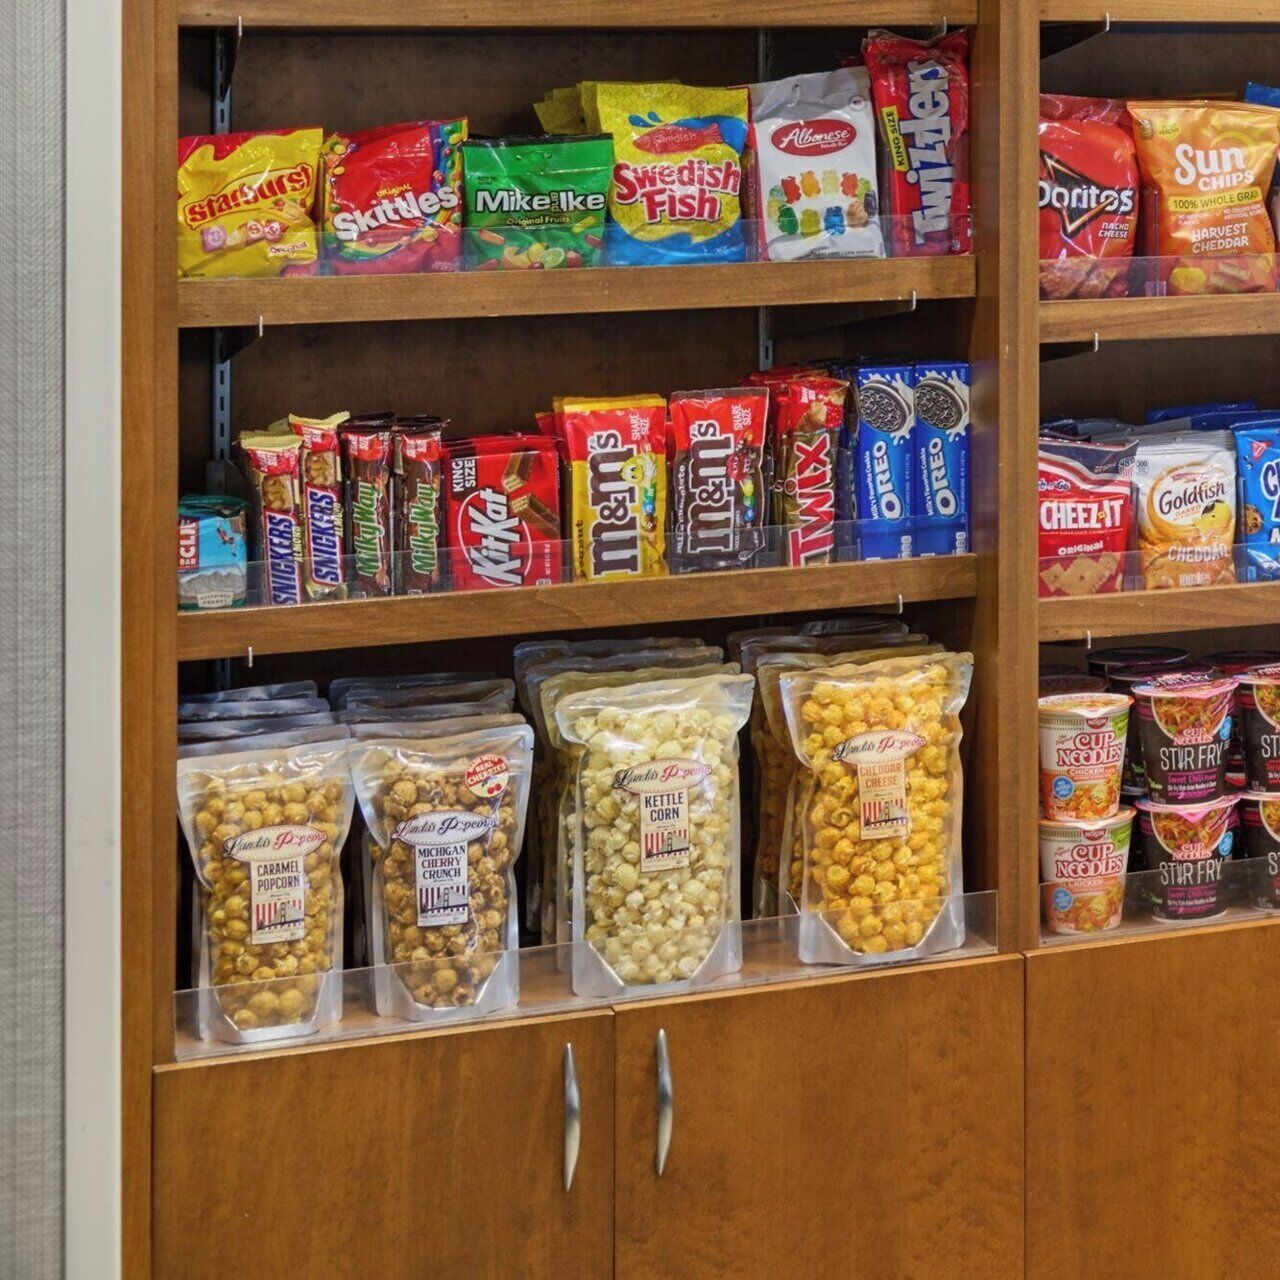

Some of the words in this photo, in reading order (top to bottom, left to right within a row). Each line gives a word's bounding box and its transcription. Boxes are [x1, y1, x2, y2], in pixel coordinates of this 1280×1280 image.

[782, 128, 850, 149] Albanese
[1174, 143, 1245, 186] Sun
[613, 160, 741, 203] Swedish
[1198, 170, 1255, 192] CHIPS
[188, 165, 312, 224] starburst
[1040, 181, 1134, 212] Doritos
[333, 186, 459, 240] Skittles
[641, 189, 721, 222] Fish
[1099, 230, 1128, 239] CHEESE
[1101, 222, 1129, 231] NACHO
[1192, 222, 1247, 243] HARVEST
[1192, 236, 1249, 254] CHEDDAR
[453, 457, 463, 492] KING
[465, 457, 476, 488] SIZE
[874, 441, 901, 520] OREO
[929, 438, 956, 516] OREO
[789, 433, 834, 568] TWIX
[1158, 482, 1225, 516] Goldfish
[310, 490, 339, 584] SNICKERS
[266, 513, 297, 605] SNICKERS
[1168, 543, 1228, 563] CHEDDAR
[1074, 733, 1115, 749] CUP
[1057, 747, 1122, 767] NOODLES
[1160, 747, 1194, 770] STIR
[1198, 741, 1224, 767] FRY
[865, 775, 897, 787] CHEESE
[645, 793, 684, 808] KETTLE
[650, 808, 680, 822] CORN
[418, 846, 466, 858] MICHIGAN
[1072, 843, 1115, 860] CUP
[257, 861, 300, 875] CARAMEL
[421, 857, 460, 868] CHERRY
[1056, 856, 1122, 877] NOODLES
[257, 875, 300, 891] POPCORN
[422, 867, 461, 880] CRUNCH
